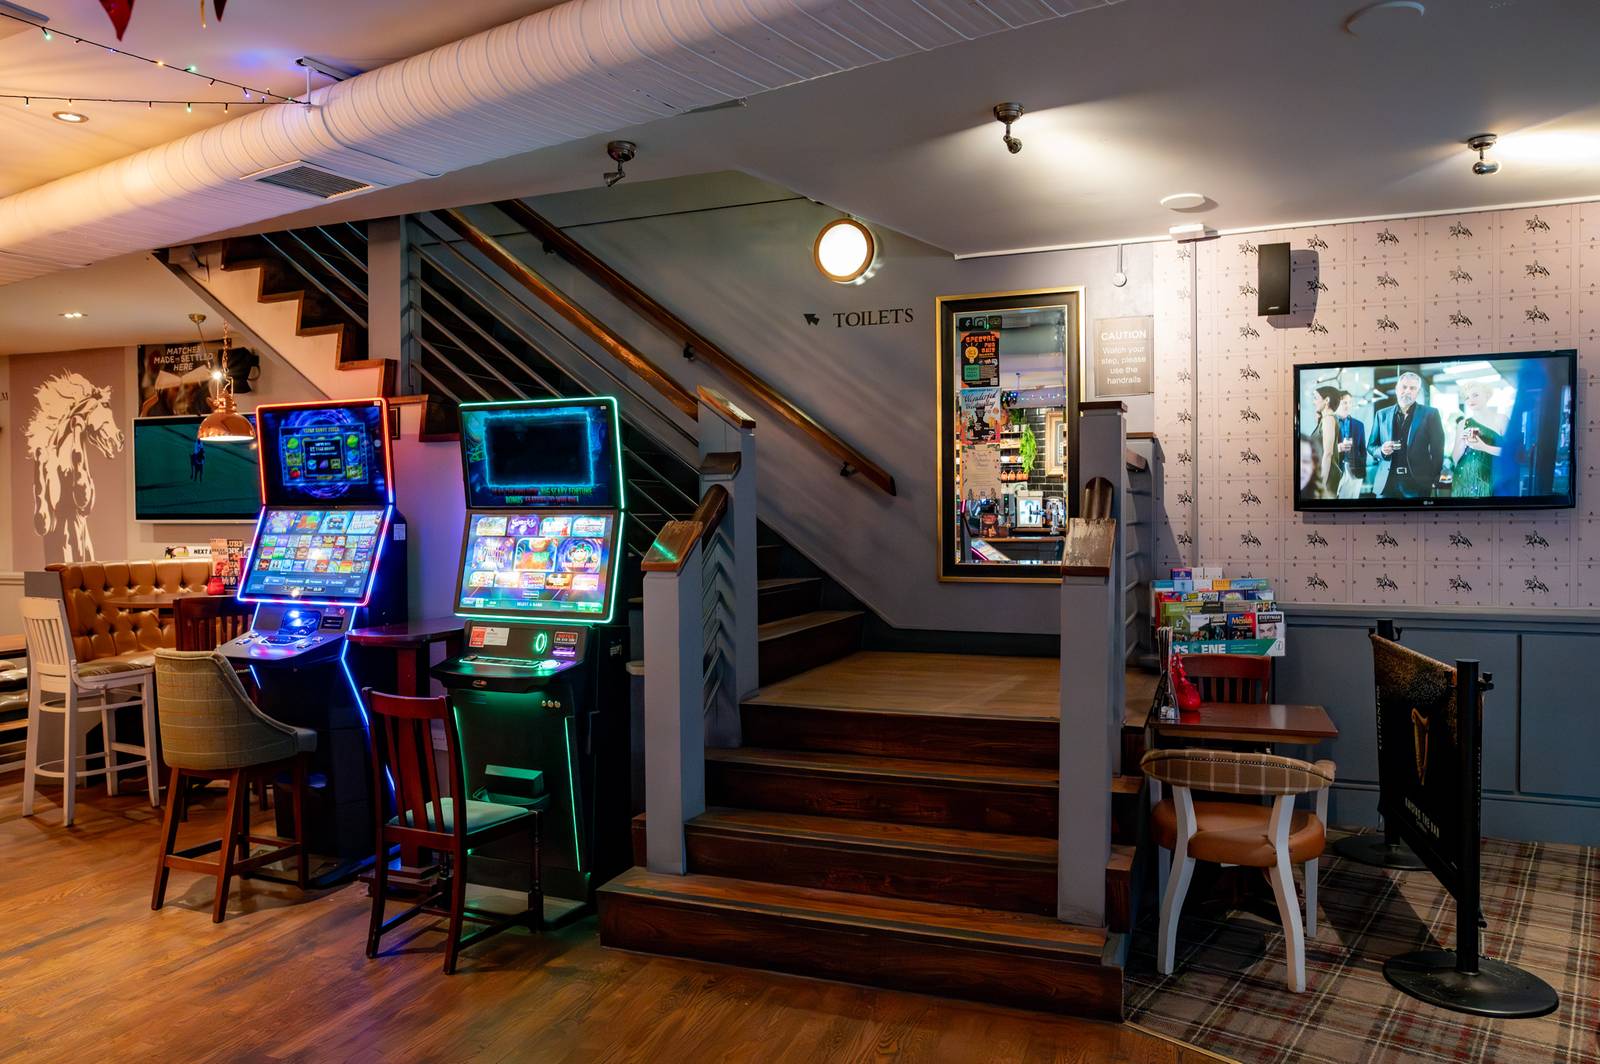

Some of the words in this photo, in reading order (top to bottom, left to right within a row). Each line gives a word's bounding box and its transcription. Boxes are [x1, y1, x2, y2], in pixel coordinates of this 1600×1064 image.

[832, 308, 914, 327] TOILETS
[1101, 329, 1147, 340] CAUTION
[1102, 346, 1126, 355] Watch
[1128, 346, 1145, 355] your
[154, 355, 175, 364] MADE
[1101, 356, 1120, 366] step,
[1121, 355, 1147, 365] please
[173, 363, 194, 371] HERE
[1125, 365, 1138, 373] the
[1107, 375, 1142, 385] handrails
